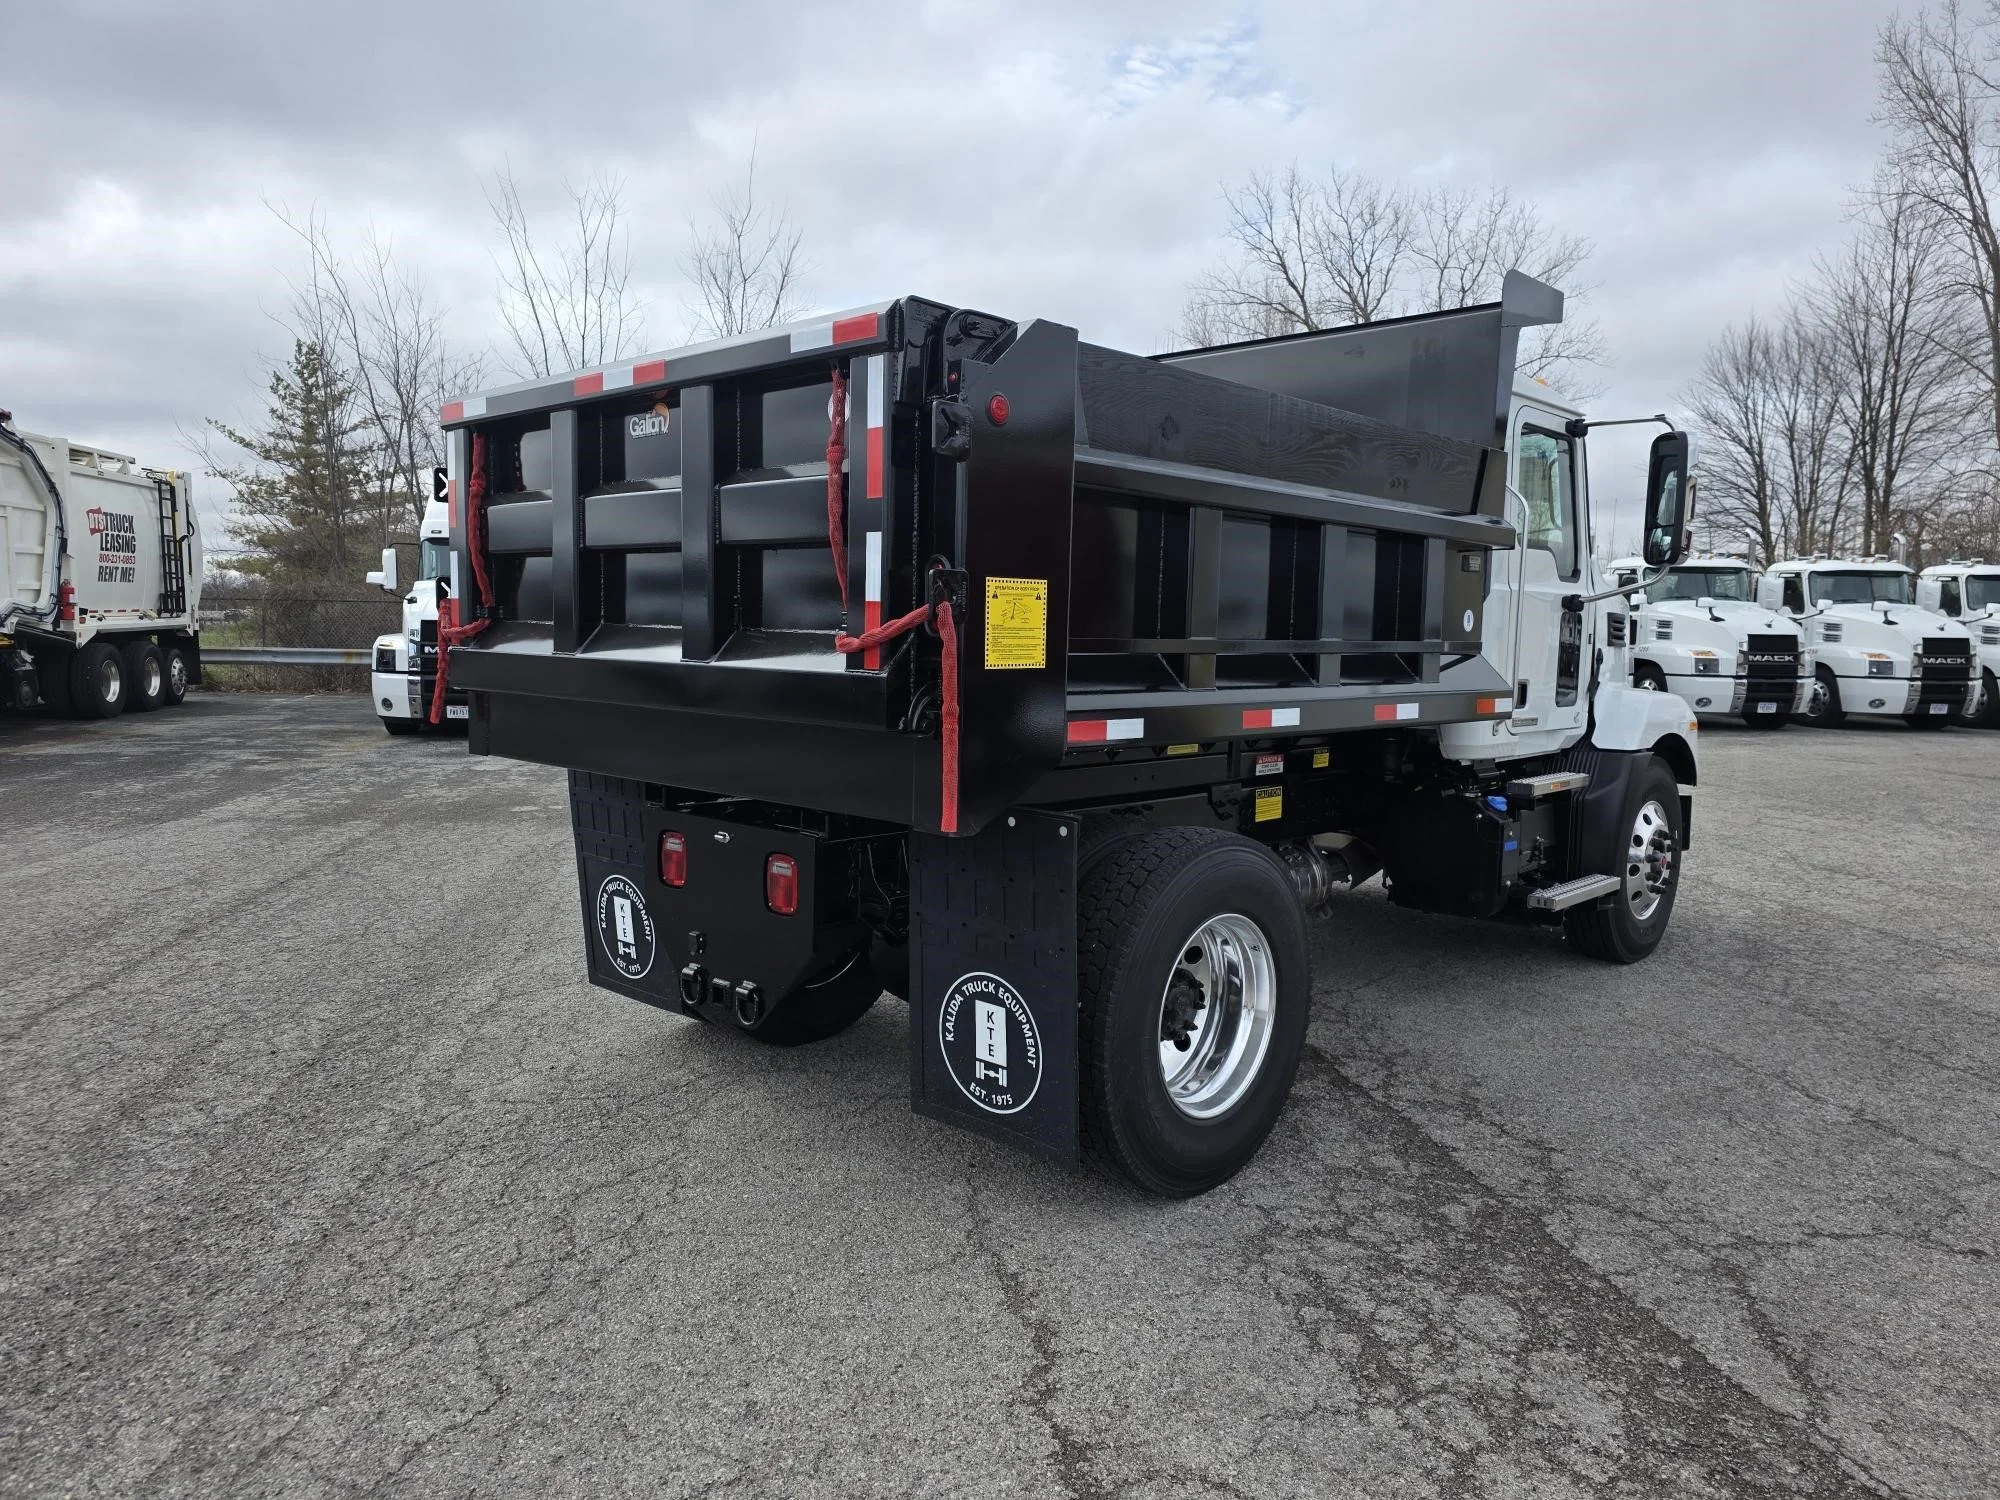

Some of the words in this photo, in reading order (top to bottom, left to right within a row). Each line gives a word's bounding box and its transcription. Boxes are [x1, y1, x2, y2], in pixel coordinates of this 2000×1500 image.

[88, 512, 104, 530] DTS
[103, 512, 134, 534] TRUCK
[100, 532, 136, 553] LEASING
[98, 565, 119, 582] RENT
[120, 567, 135, 583] ME!
[1257, 788, 1281, 799] CAUTION
[600, 892, 609, 929] KALIDA
[605, 881, 625, 894] TRUCK
[625, 885, 652, 942] EQUIPMENT
[616, 957, 628, 971] EST.
[628, 963, 641, 973] 1975
[945, 994, 964, 1042] KALIDA
[961, 980, 996, 997] TRUCK
[998, 986, 1036, 1068] EQUIPMENT
[969, 1082, 989, 1102] EST.
[991, 1094, 1013, 1106] 1975
